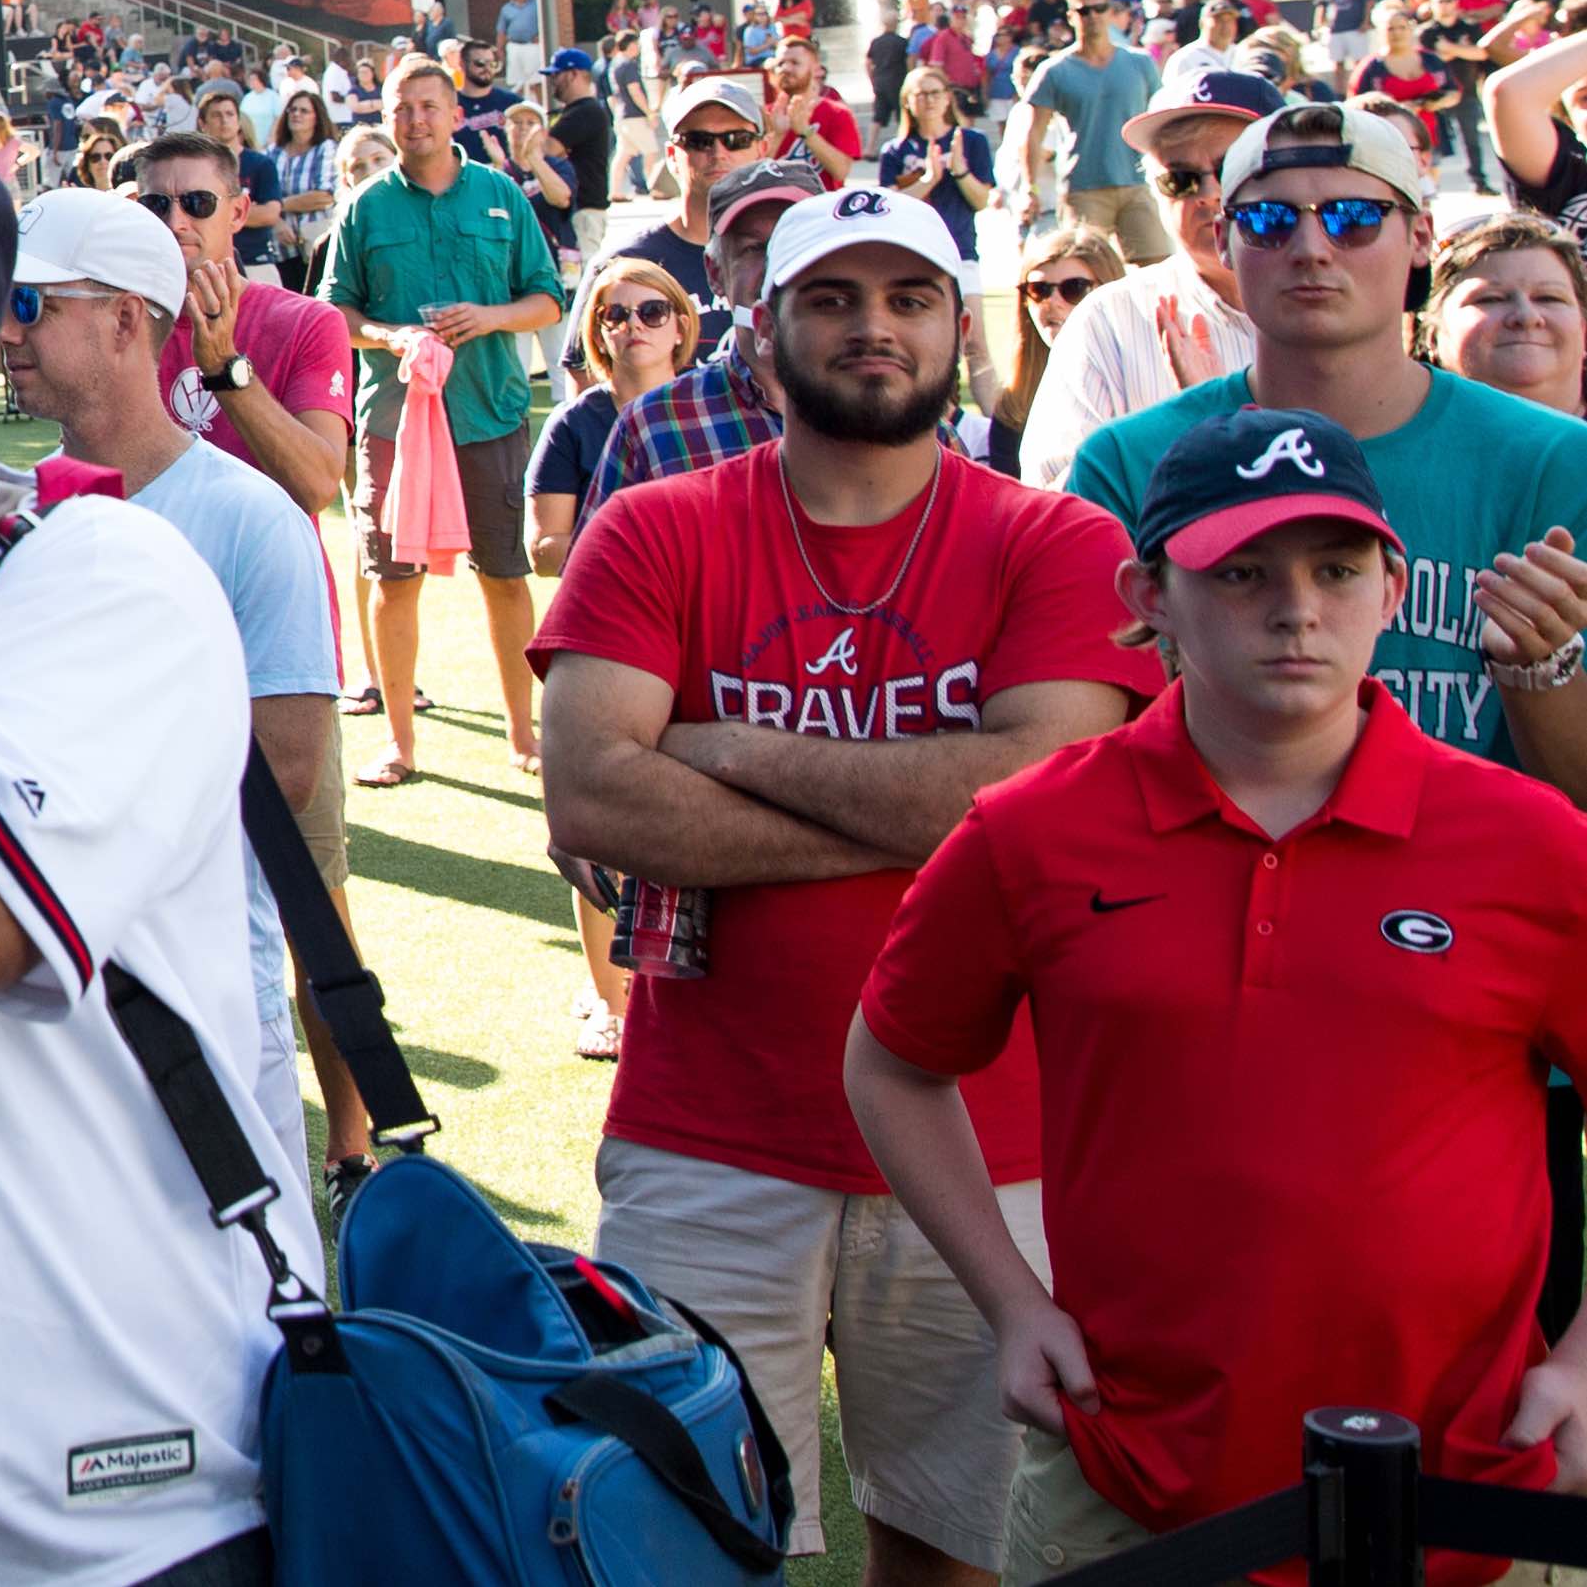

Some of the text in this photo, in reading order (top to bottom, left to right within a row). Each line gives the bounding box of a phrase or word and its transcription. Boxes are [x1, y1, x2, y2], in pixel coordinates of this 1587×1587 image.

[1236, 427, 1324, 478] A
[804, 627, 858, 676] A
[106, 1445, 183, 1470] Majestic
